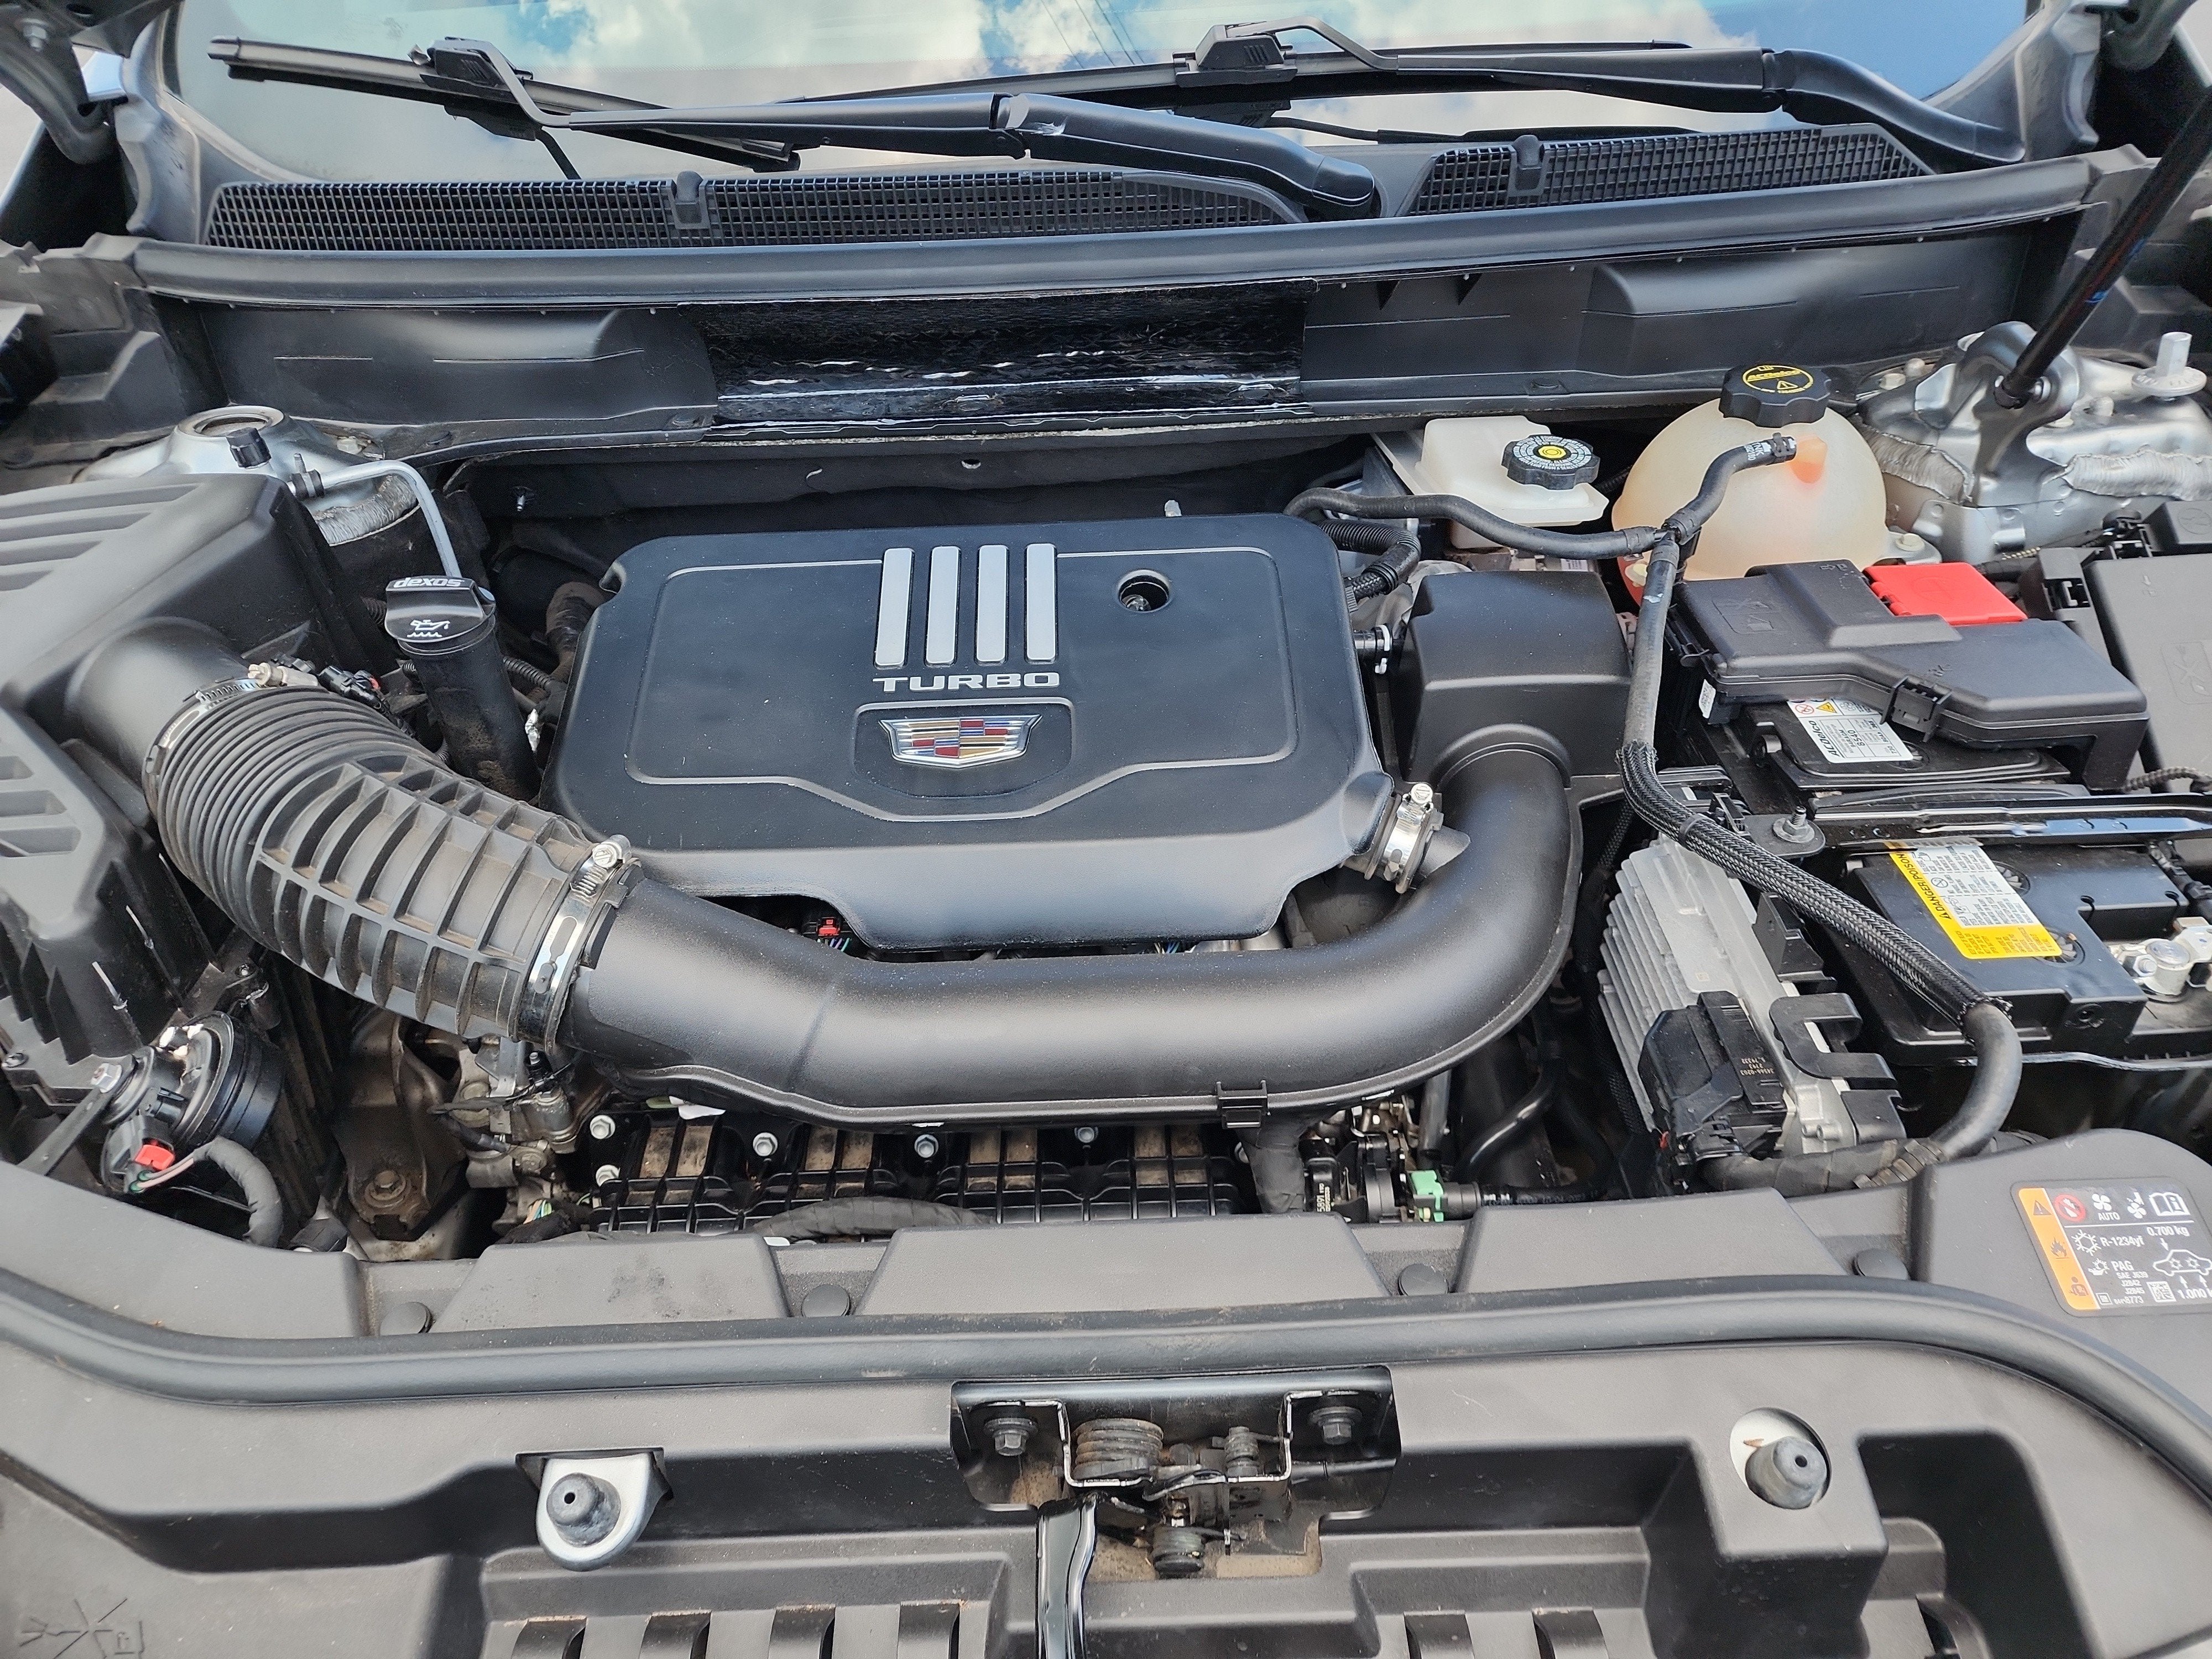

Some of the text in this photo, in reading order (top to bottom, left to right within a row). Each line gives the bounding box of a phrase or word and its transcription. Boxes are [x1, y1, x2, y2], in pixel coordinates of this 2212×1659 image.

[393, 577, 461, 588] dexos
[873, 672, 1060, 692] TURBO
[1808, 721, 1840, 757] ACDelco
[1848, 730, 1865, 746] 8540
[1897, 853, 1945, 911] DANGER/POISON
[2098, 1212, 2120, 1221] AUTO
[2146, 1226, 2190, 1237] 0.700 kg
[2100, 1235, 2145, 1247] R-1234yf
[2111, 1261, 2135, 1271] PAG
[2177, 1288, 2208, 1299] 1.000
